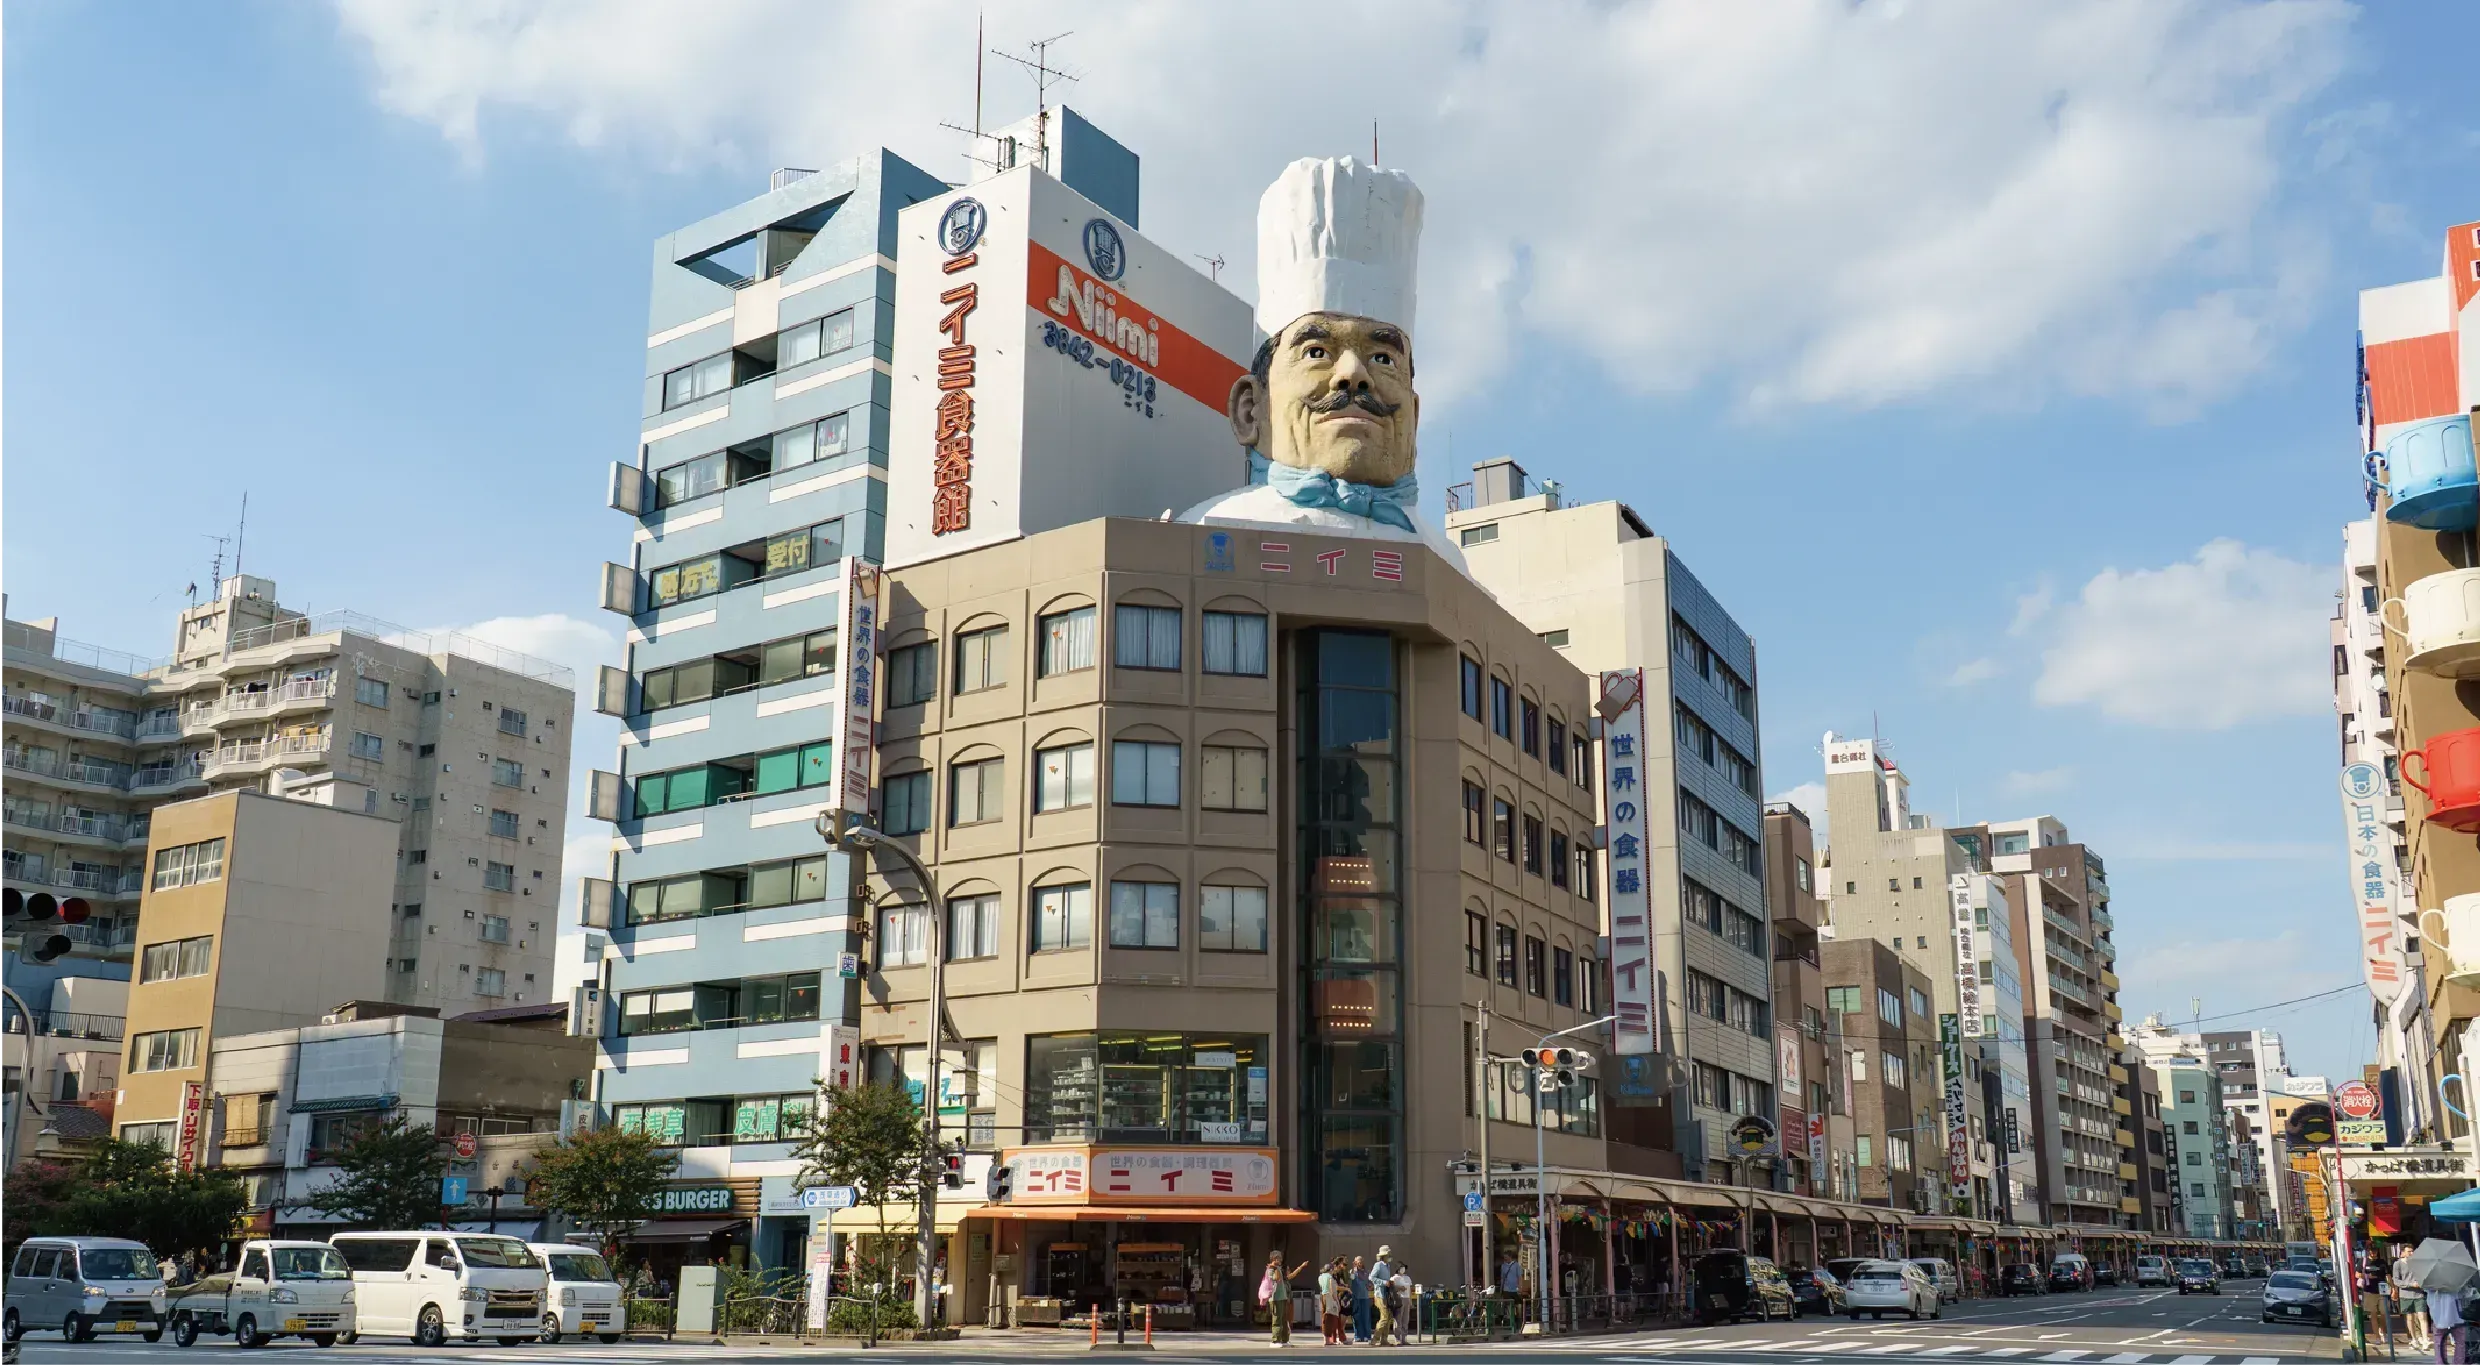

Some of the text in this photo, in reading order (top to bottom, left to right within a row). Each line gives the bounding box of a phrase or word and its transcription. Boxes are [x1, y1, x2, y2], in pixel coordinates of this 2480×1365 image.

[1047, 264, 1158, 367] Niimi
[1044, 321, 1156, 402] 3842-0213
[932, 252, 979, 537] ニイミ食器館
[766, 535, 809, 572] 受付
[1261, 543, 1402, 581] ニイミ
[848, 605, 872, 800] 世界の食器 ニイミ
[1611, 733, 1649, 1034] 世界の食器 ニイミ
[2356, 803, 2400, 983] 日本の食器 ニイミ
[842, 954, 855, 973] 歯
[1942, 1014, 1961, 1074] ショーケース
[1952, 1078, 1965, 1124] イシヤマ
[2342, 1094, 2372, 1108] 消火栓
[623, 1107, 685, 1138] 西浅草
[1203, 1125, 1238, 1135] NIKKO
[2340, 1123, 2384, 1135] カジワラ
[1028, 1155, 1083, 1168] 世界の食器
[1951, 1130, 1967, 1178] かんばん
[2364, 1158, 2465, 1173] かっぱ橋道具街
[1027, 1169, 1082, 1192] ニイミ
[1109, 1169, 1233, 1192] ニイミ
[665, 1189, 729, 1210] BURGER
